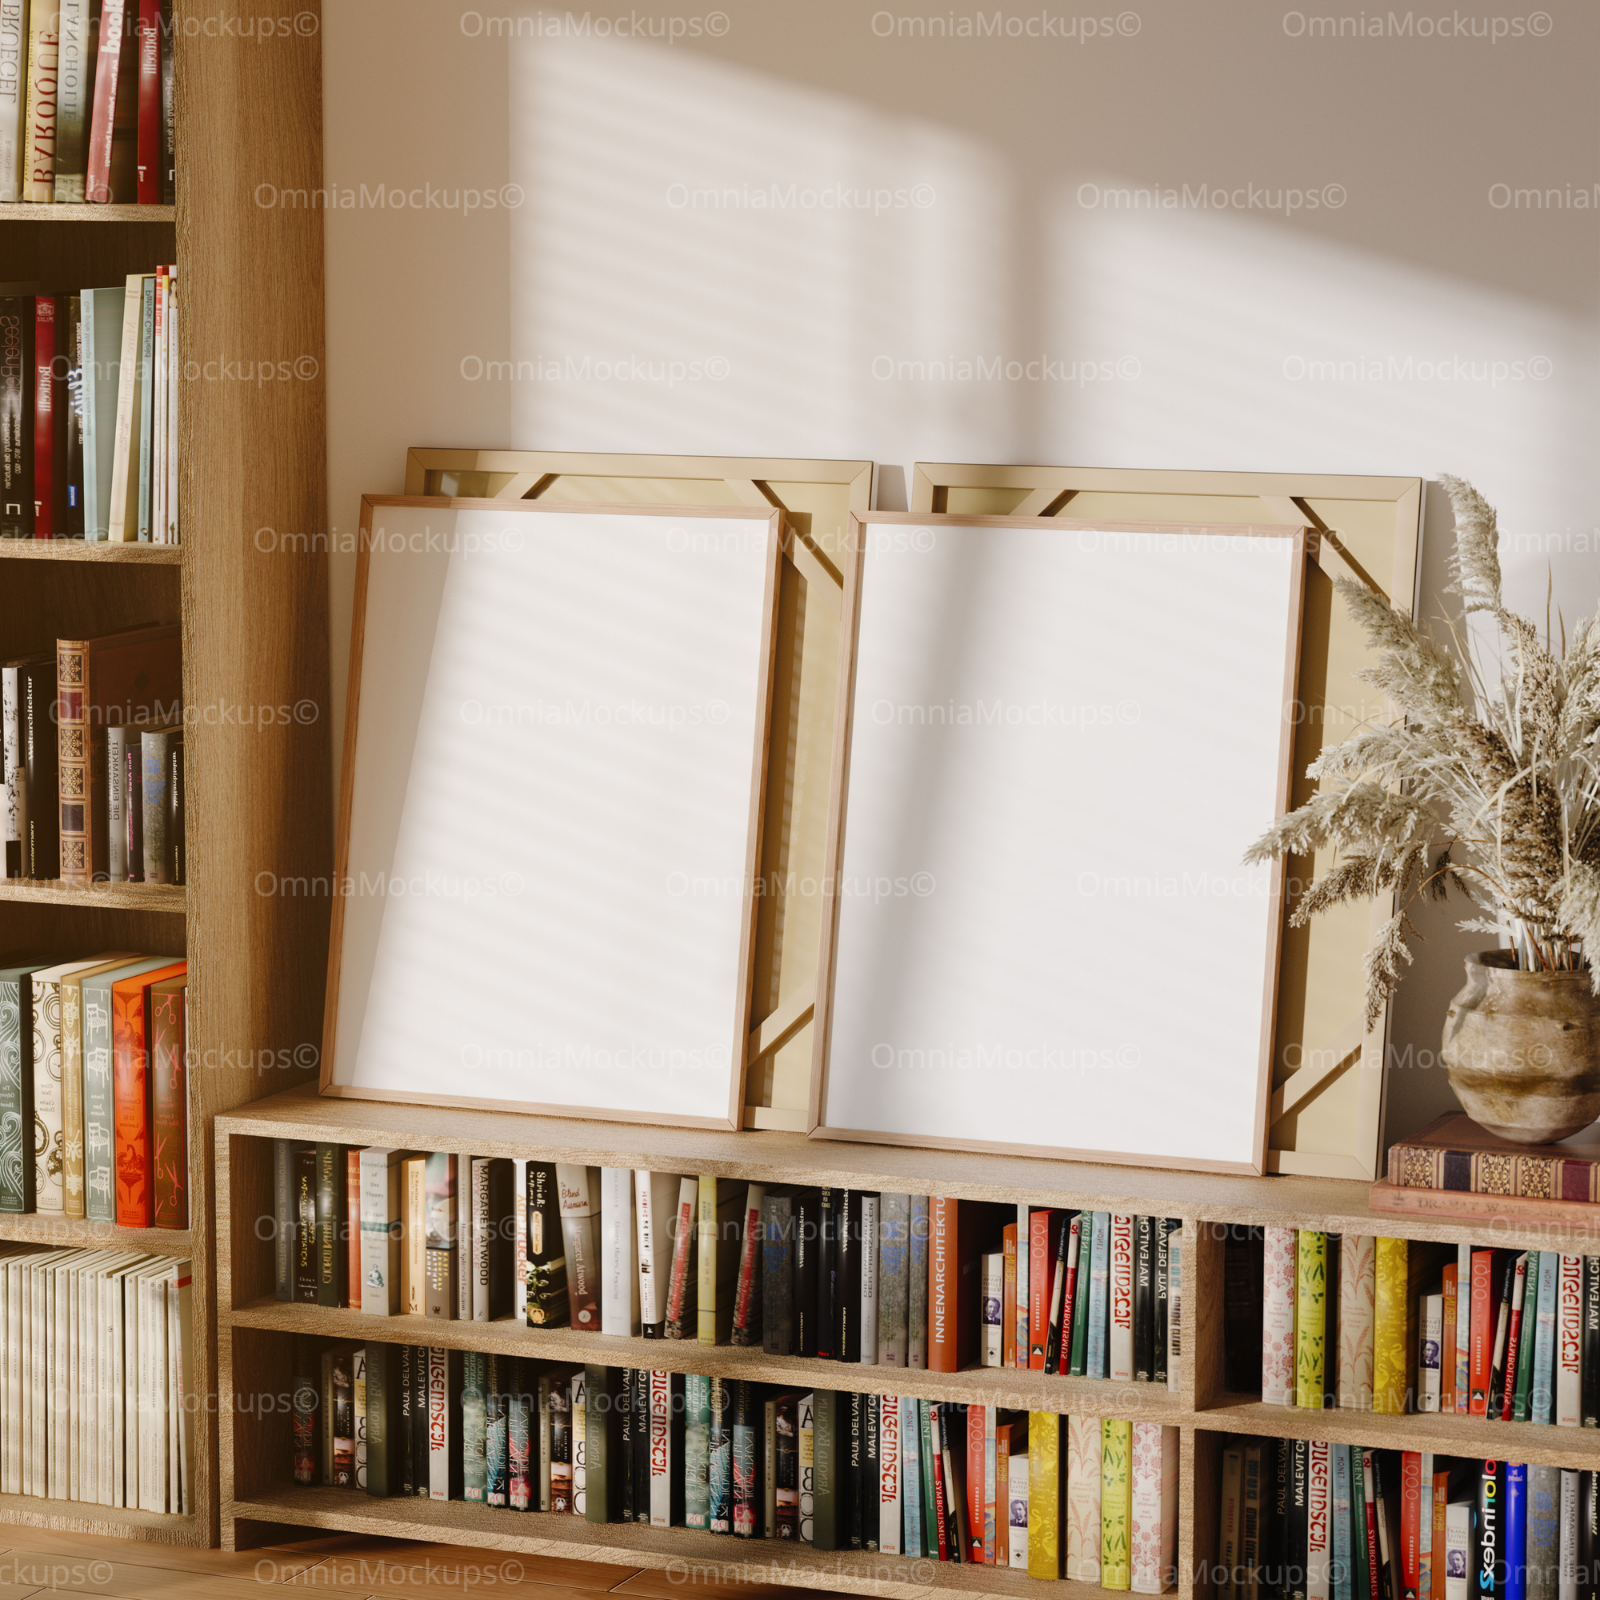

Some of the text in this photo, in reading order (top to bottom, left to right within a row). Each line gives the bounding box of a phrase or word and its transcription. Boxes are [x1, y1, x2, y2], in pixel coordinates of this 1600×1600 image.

[26, 676, 34, 760] Weltarchitektur
[480, 1165, 488, 1286] MARGARET ATWOOD
[572, 1225, 587, 1295] Margaret Atwood
[935, 1197, 946, 1343] INNENARCHITEKTU
[402, 1345, 411, 1417] PAUL DELVAU
[851, 1394, 860, 1467] PAUL DELVAU
[922, 1400, 930, 1439] ARGENT
[971, 1413, 983, 1453] 1900
[998, 1454, 1008, 1482] BERLIN
[1277, 1439, 1287, 1515] PAUL DELVAU
[1353, 1446, 1363, 1487] ARGENT
[1405, 1460, 1419, 1501] 1900
[935, 1480, 946, 1545] SYMBOLISMUS
[1434, 1502, 1445, 1531] BERLIN
[1367, 1529, 1378, 1597] SYMBOLISMUS
